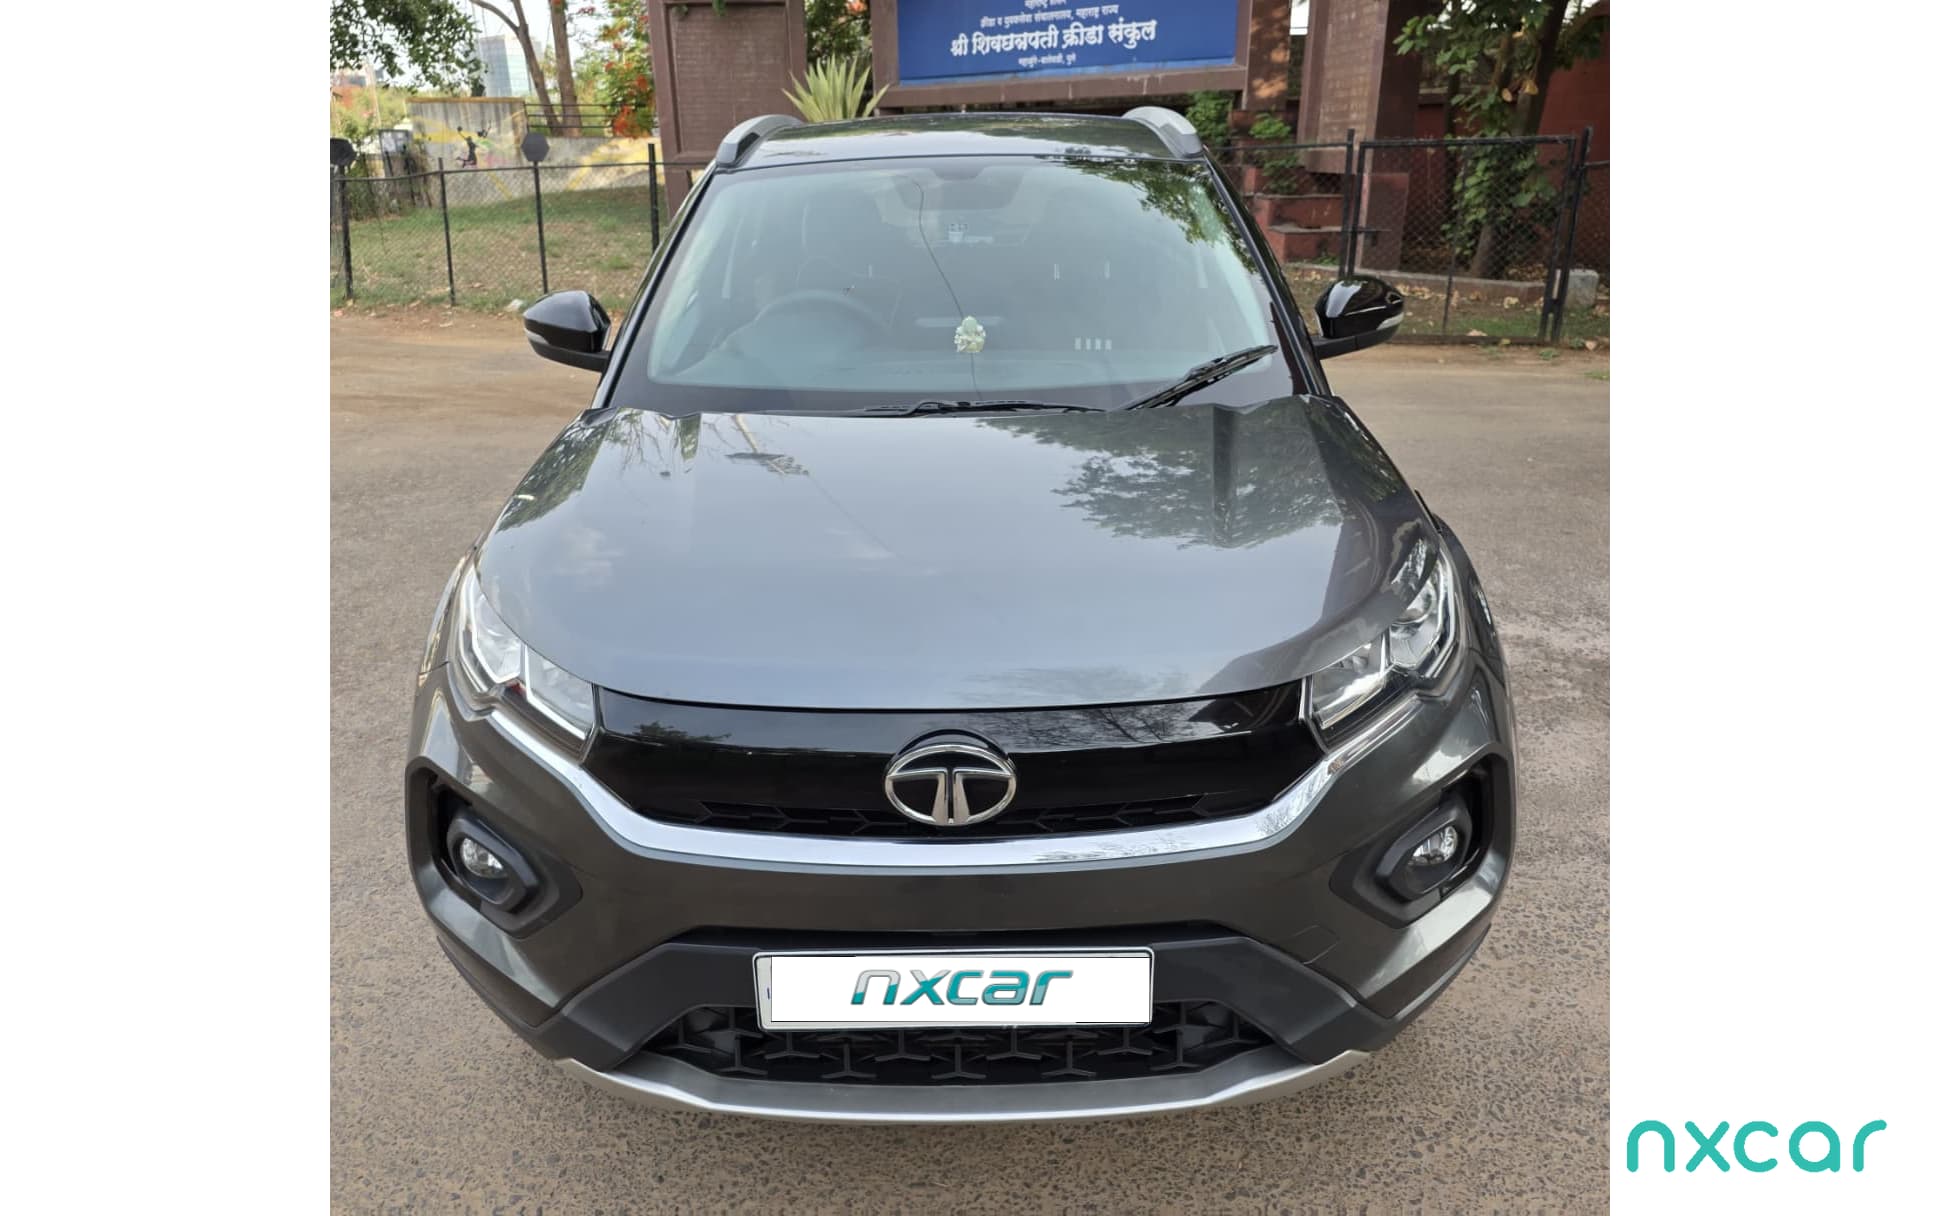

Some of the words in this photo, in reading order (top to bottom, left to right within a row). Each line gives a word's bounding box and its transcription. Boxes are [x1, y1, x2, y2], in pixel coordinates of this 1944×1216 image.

[951, 33, 968, 57] श्री
[972, 24, 1059, 56] शिवछत्रपती
[1062, 22, 1104, 49] क्रीडा
[1108, 17, 1158, 49] संकुल
